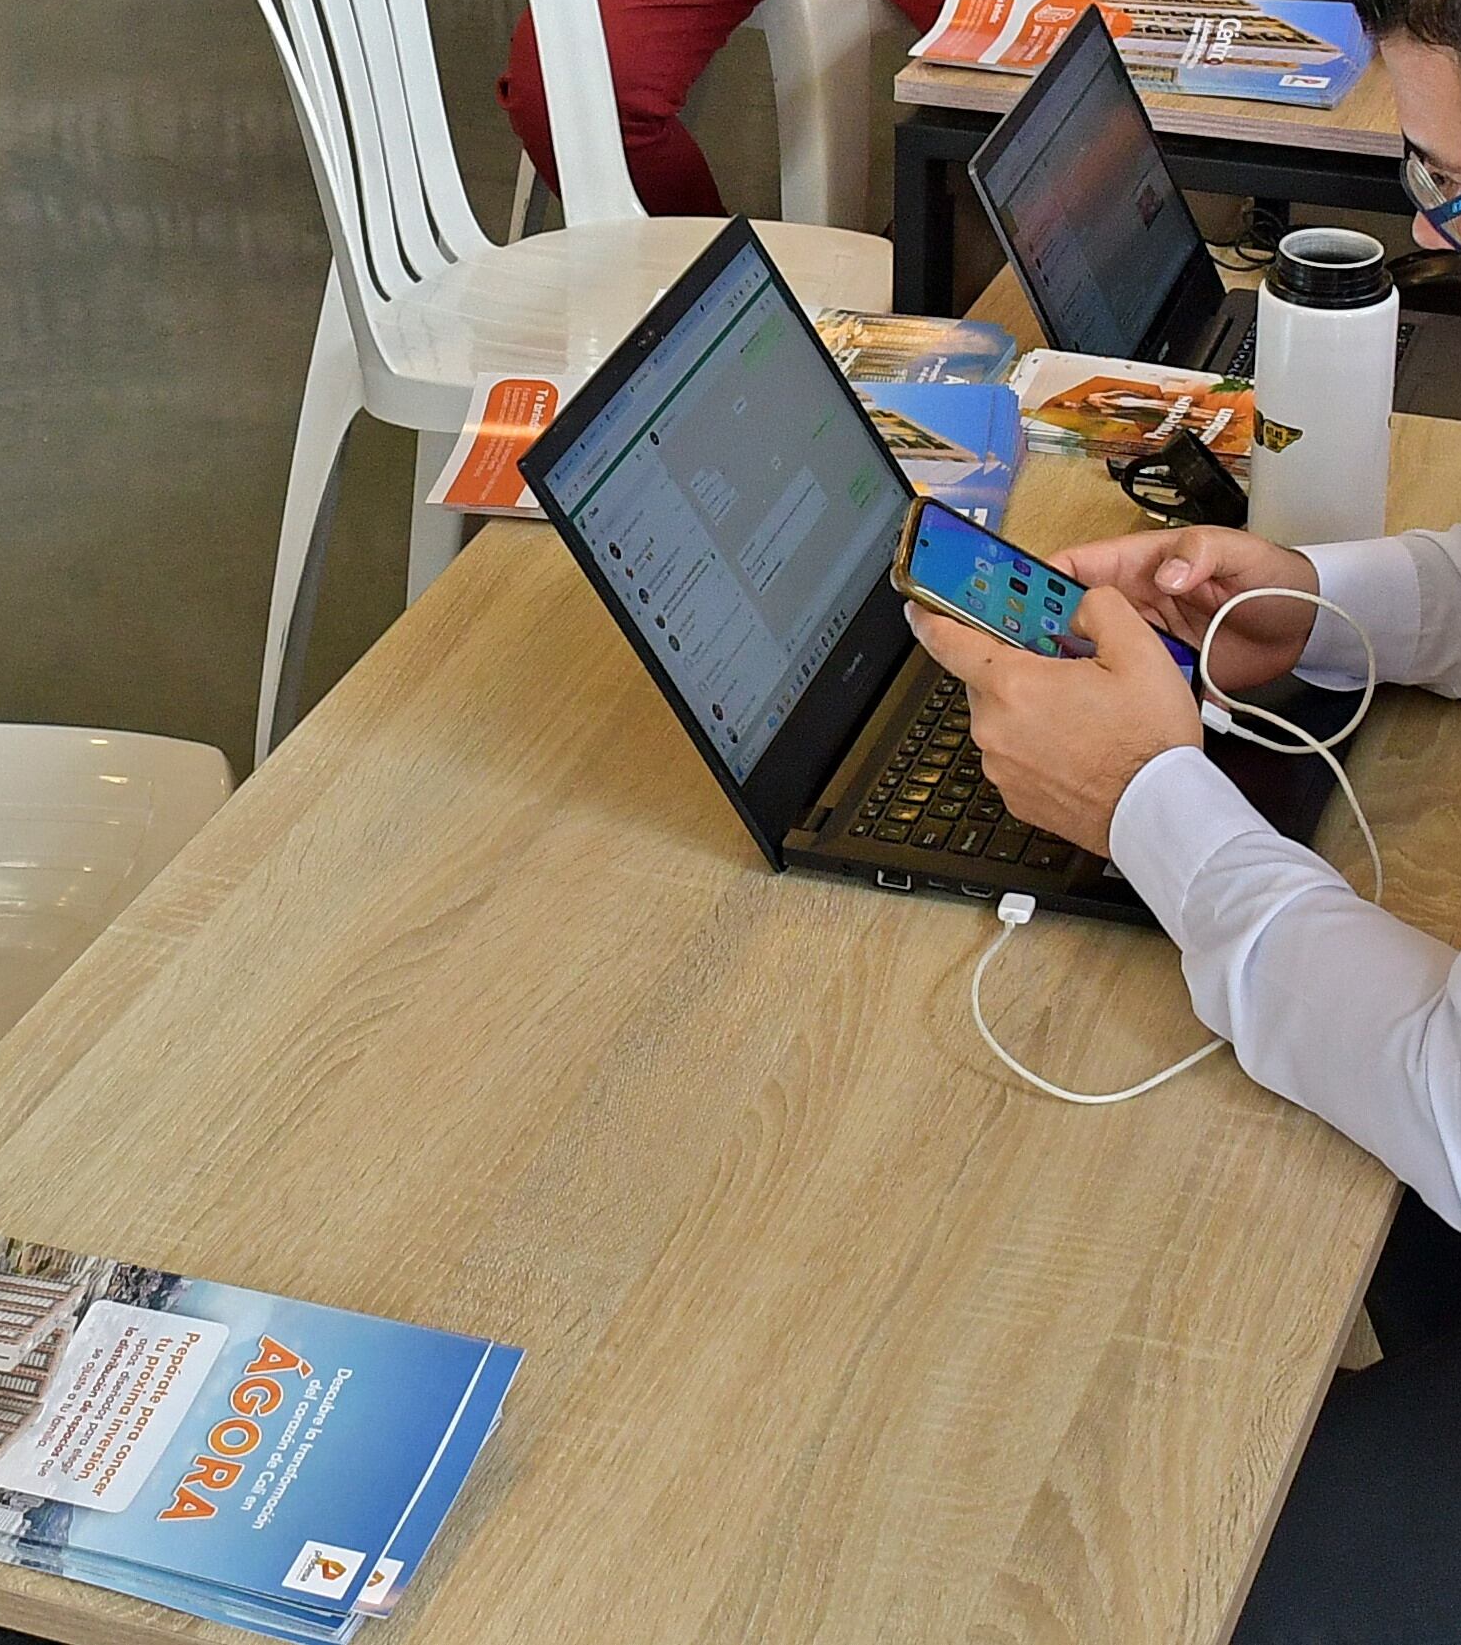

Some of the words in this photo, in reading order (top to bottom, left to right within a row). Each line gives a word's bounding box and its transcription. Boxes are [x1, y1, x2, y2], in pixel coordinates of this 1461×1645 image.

[124, 1326, 139, 1338] la
[154, 1336, 174, 1354] tu
[88, 1339, 130, 1399] distribución
[118, 1354, 161, 1416] próxima
[150, 1330, 201, 1404] Prepárate
[79, 1400, 94, 1414] de
[94, 1370, 132, 1421] diseñados
[303, 1378, 324, 1401] del
[312, 1367, 354, 1426] Descubre
[50, 1415, 83, 1458] espacios
[79, 1421, 99, 1447] para
[127, 1405, 155, 1442] para
[155, 1333, 315, 1523] ÁGORA
[276, 1401, 309, 1451] corazón
[304, 1428, 323, 1441] la
[37, 1458, 54, 1477] que
[73, 1417, 129, 1482] inversión,
[266, 1452, 284, 1470] de
[92, 1444, 133, 1498] conocer
[250, 1471, 276, 1496] Cali
[251, 1442, 314, 1530] transformación
[240, 1495, 257, 1511] en
